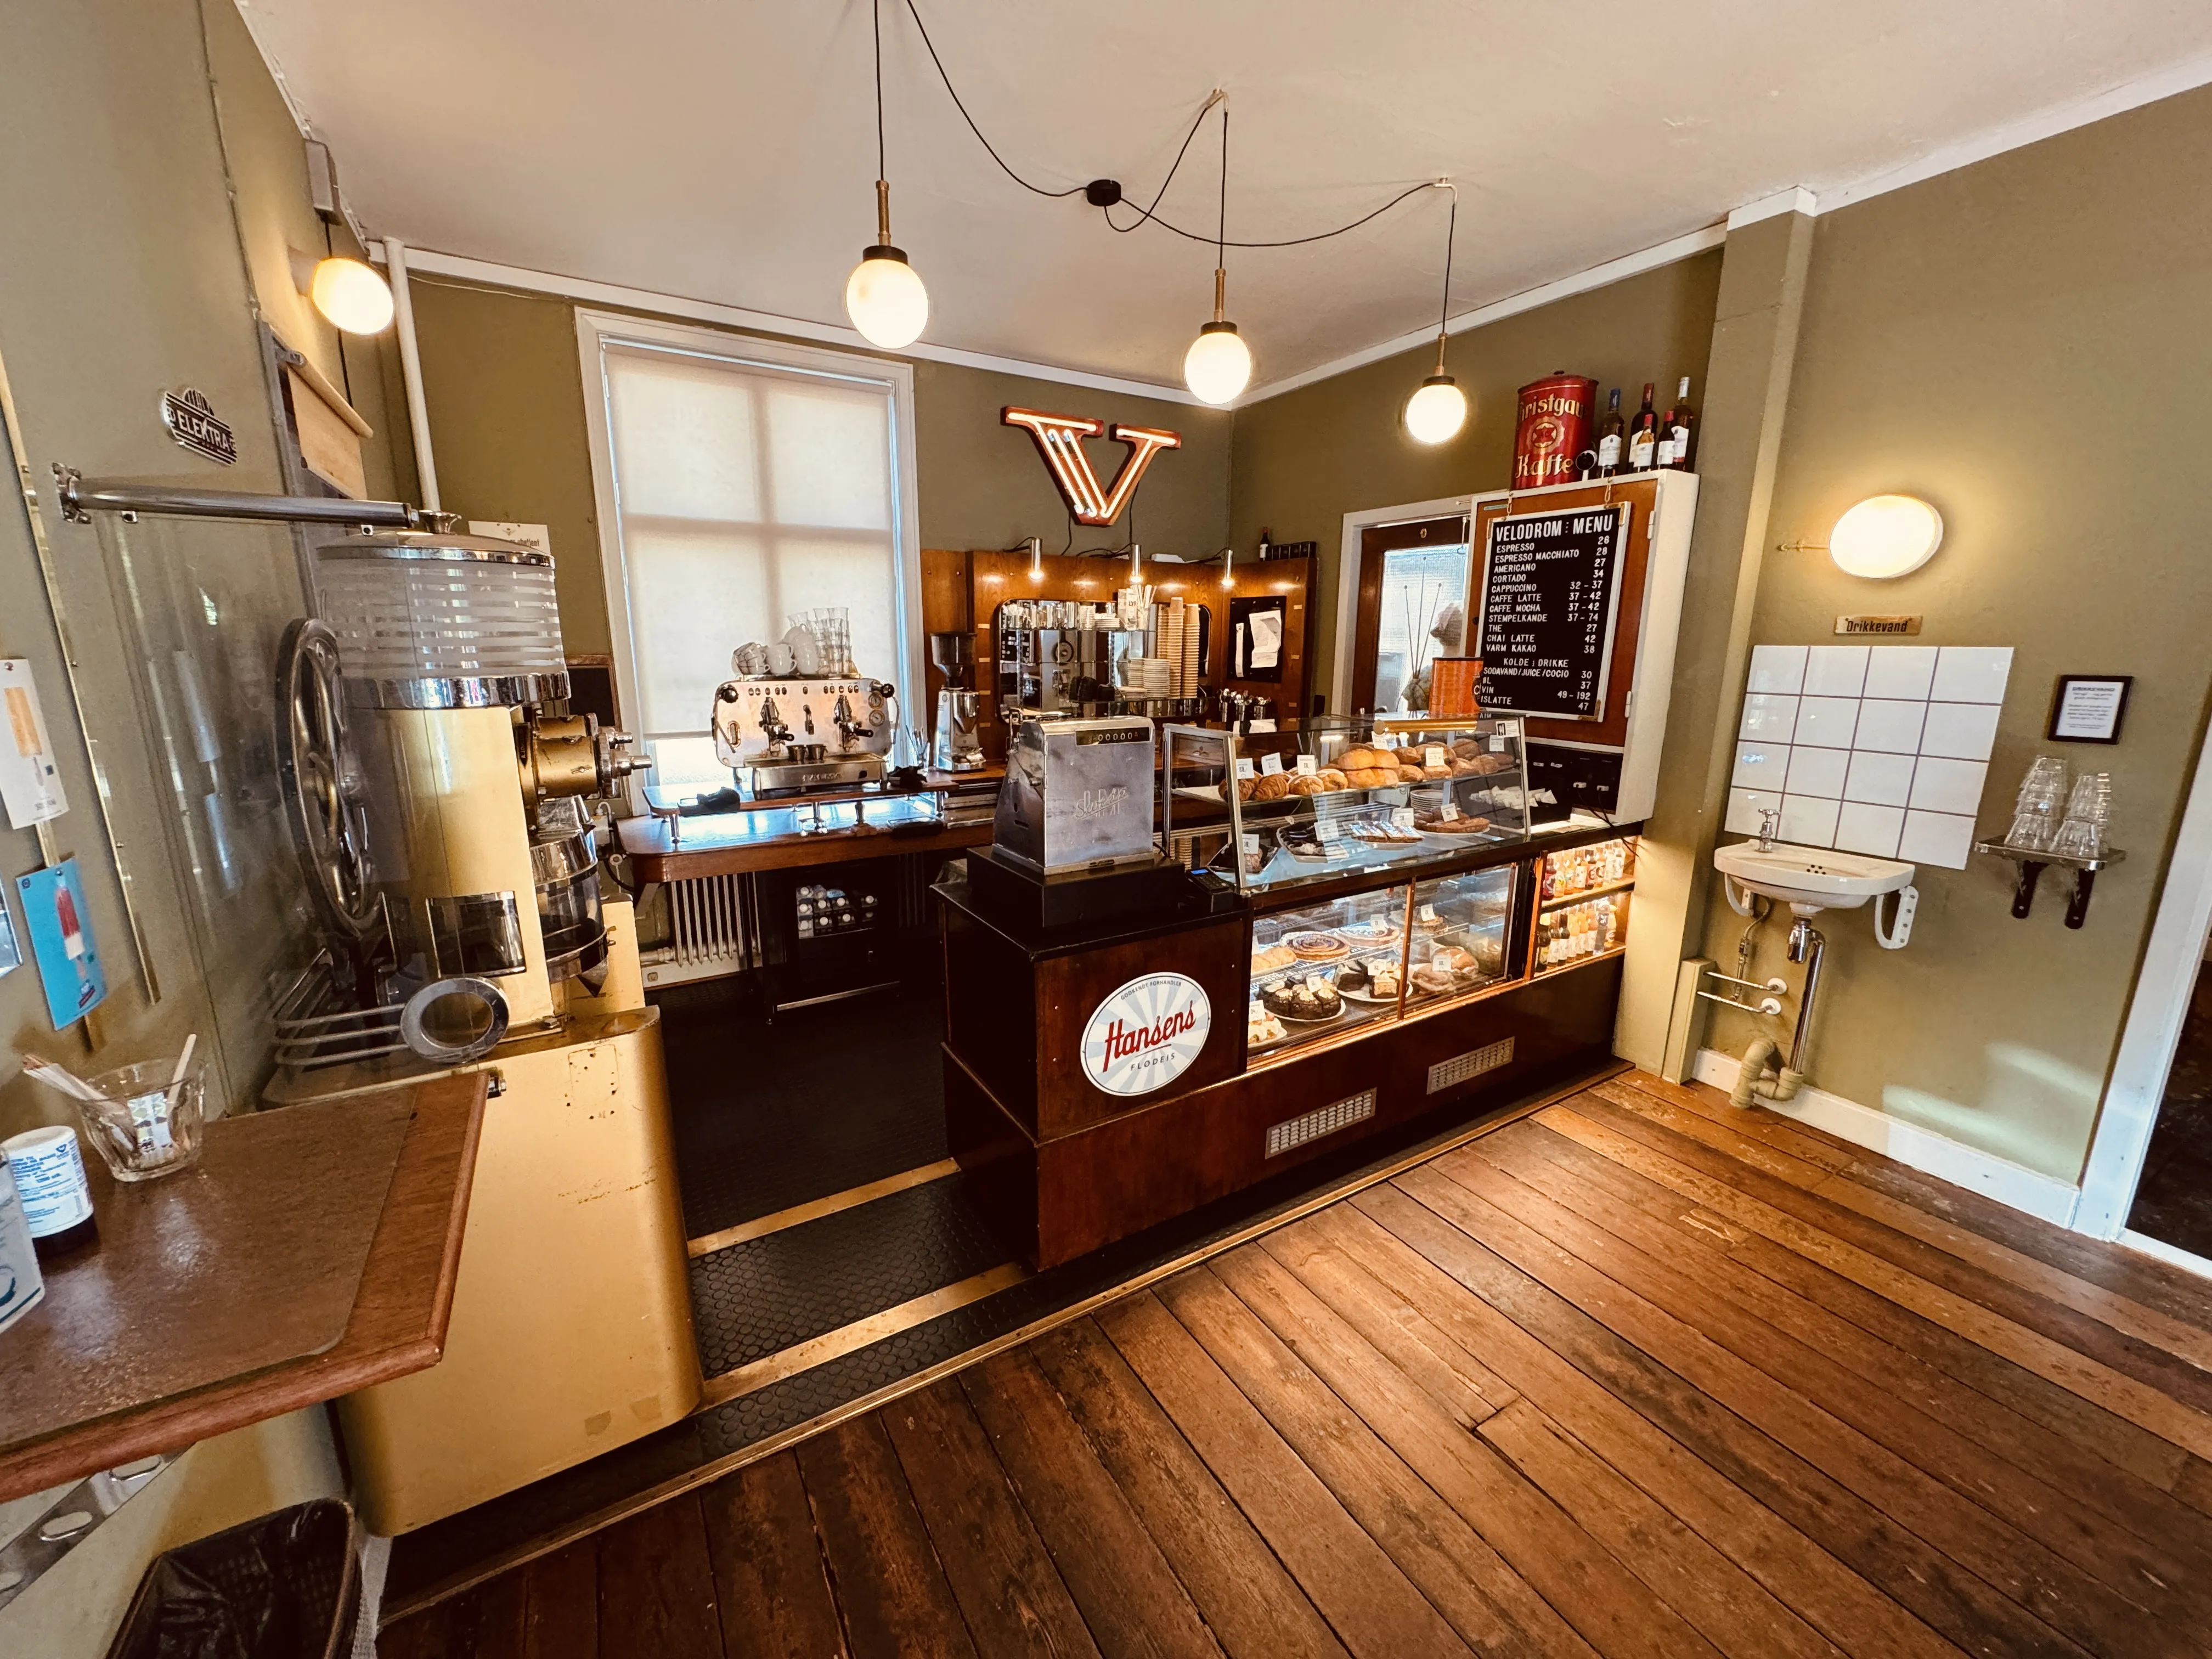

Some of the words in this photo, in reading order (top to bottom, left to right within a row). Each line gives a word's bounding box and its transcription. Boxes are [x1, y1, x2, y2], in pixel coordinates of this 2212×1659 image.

[1001, 406, 1181, 528] V
[1515, 453, 1574, 479] Kaffe
[1496, 520, 1562, 542] VELODROM
[1573, 514, 1613, 534] MENU
[1495, 552, 1533, 563] ESPRESSO
[1535, 549, 1579, 560] MACCHIATO
[1596, 546, 1607, 556] 28
[1496, 542, 1535, 554] ESPRESSO
[1494, 563, 1536, 573] AMERICANO
[1594, 558, 1606, 567] 27
[1493, 573, 1526, 583] CORTADO
[1593, 569, 1604, 578] 34
[1491, 583, 1537, 594] CAPPUCCINO
[1570, 581, 1581, 590] 32
[1592, 580, 1603, 589] 37
[1491, 594, 1513, 603] CAFFE
[1517, 593, 1542, 602] LATTE
[1568, 592, 1579, 601] 37
[1589, 591, 1601, 600] 42
[1489, 604, 1511, 613] CAFFE
[1516, 603, 1541, 612] MOCHA
[1568, 602, 1579, 611] 37
[1588, 602, 1600, 611] 42
[1488, 613, 1548, 623] STEMPELKANDE
[1567, 613, 1578, 622] 37
[1588, 613, 1599, 622] 74
[1488, 624, 1503, 633] THE
[1586, 623, 1598, 633] 27
[1846, 620, 1909, 633] Drikkevand
[1511, 634, 1535, 642] LATTE
[1584, 634, 1596, 643] 42
[1486, 644, 1506, 652] VARM
[1511, 644, 1537, 652] KAKAO
[1584, 645, 1595, 653] 38
[1503, 658, 1530, 667] KOLDE
[1538, 658, 1568, 668] DRIKKE
[1581, 670, 1592, 679] 30
[1580, 681, 1591, 690] 37
[1481, 686, 1494, 694] VIN
[1557, 690, 1567, 698] 49
[1577, 691, 1591, 700] 192
[1480, 695, 1512, 705] ISLATTE
[1578, 702, 1589, 710] 47
[1102, 1000, 1197, 1073] Hansens
